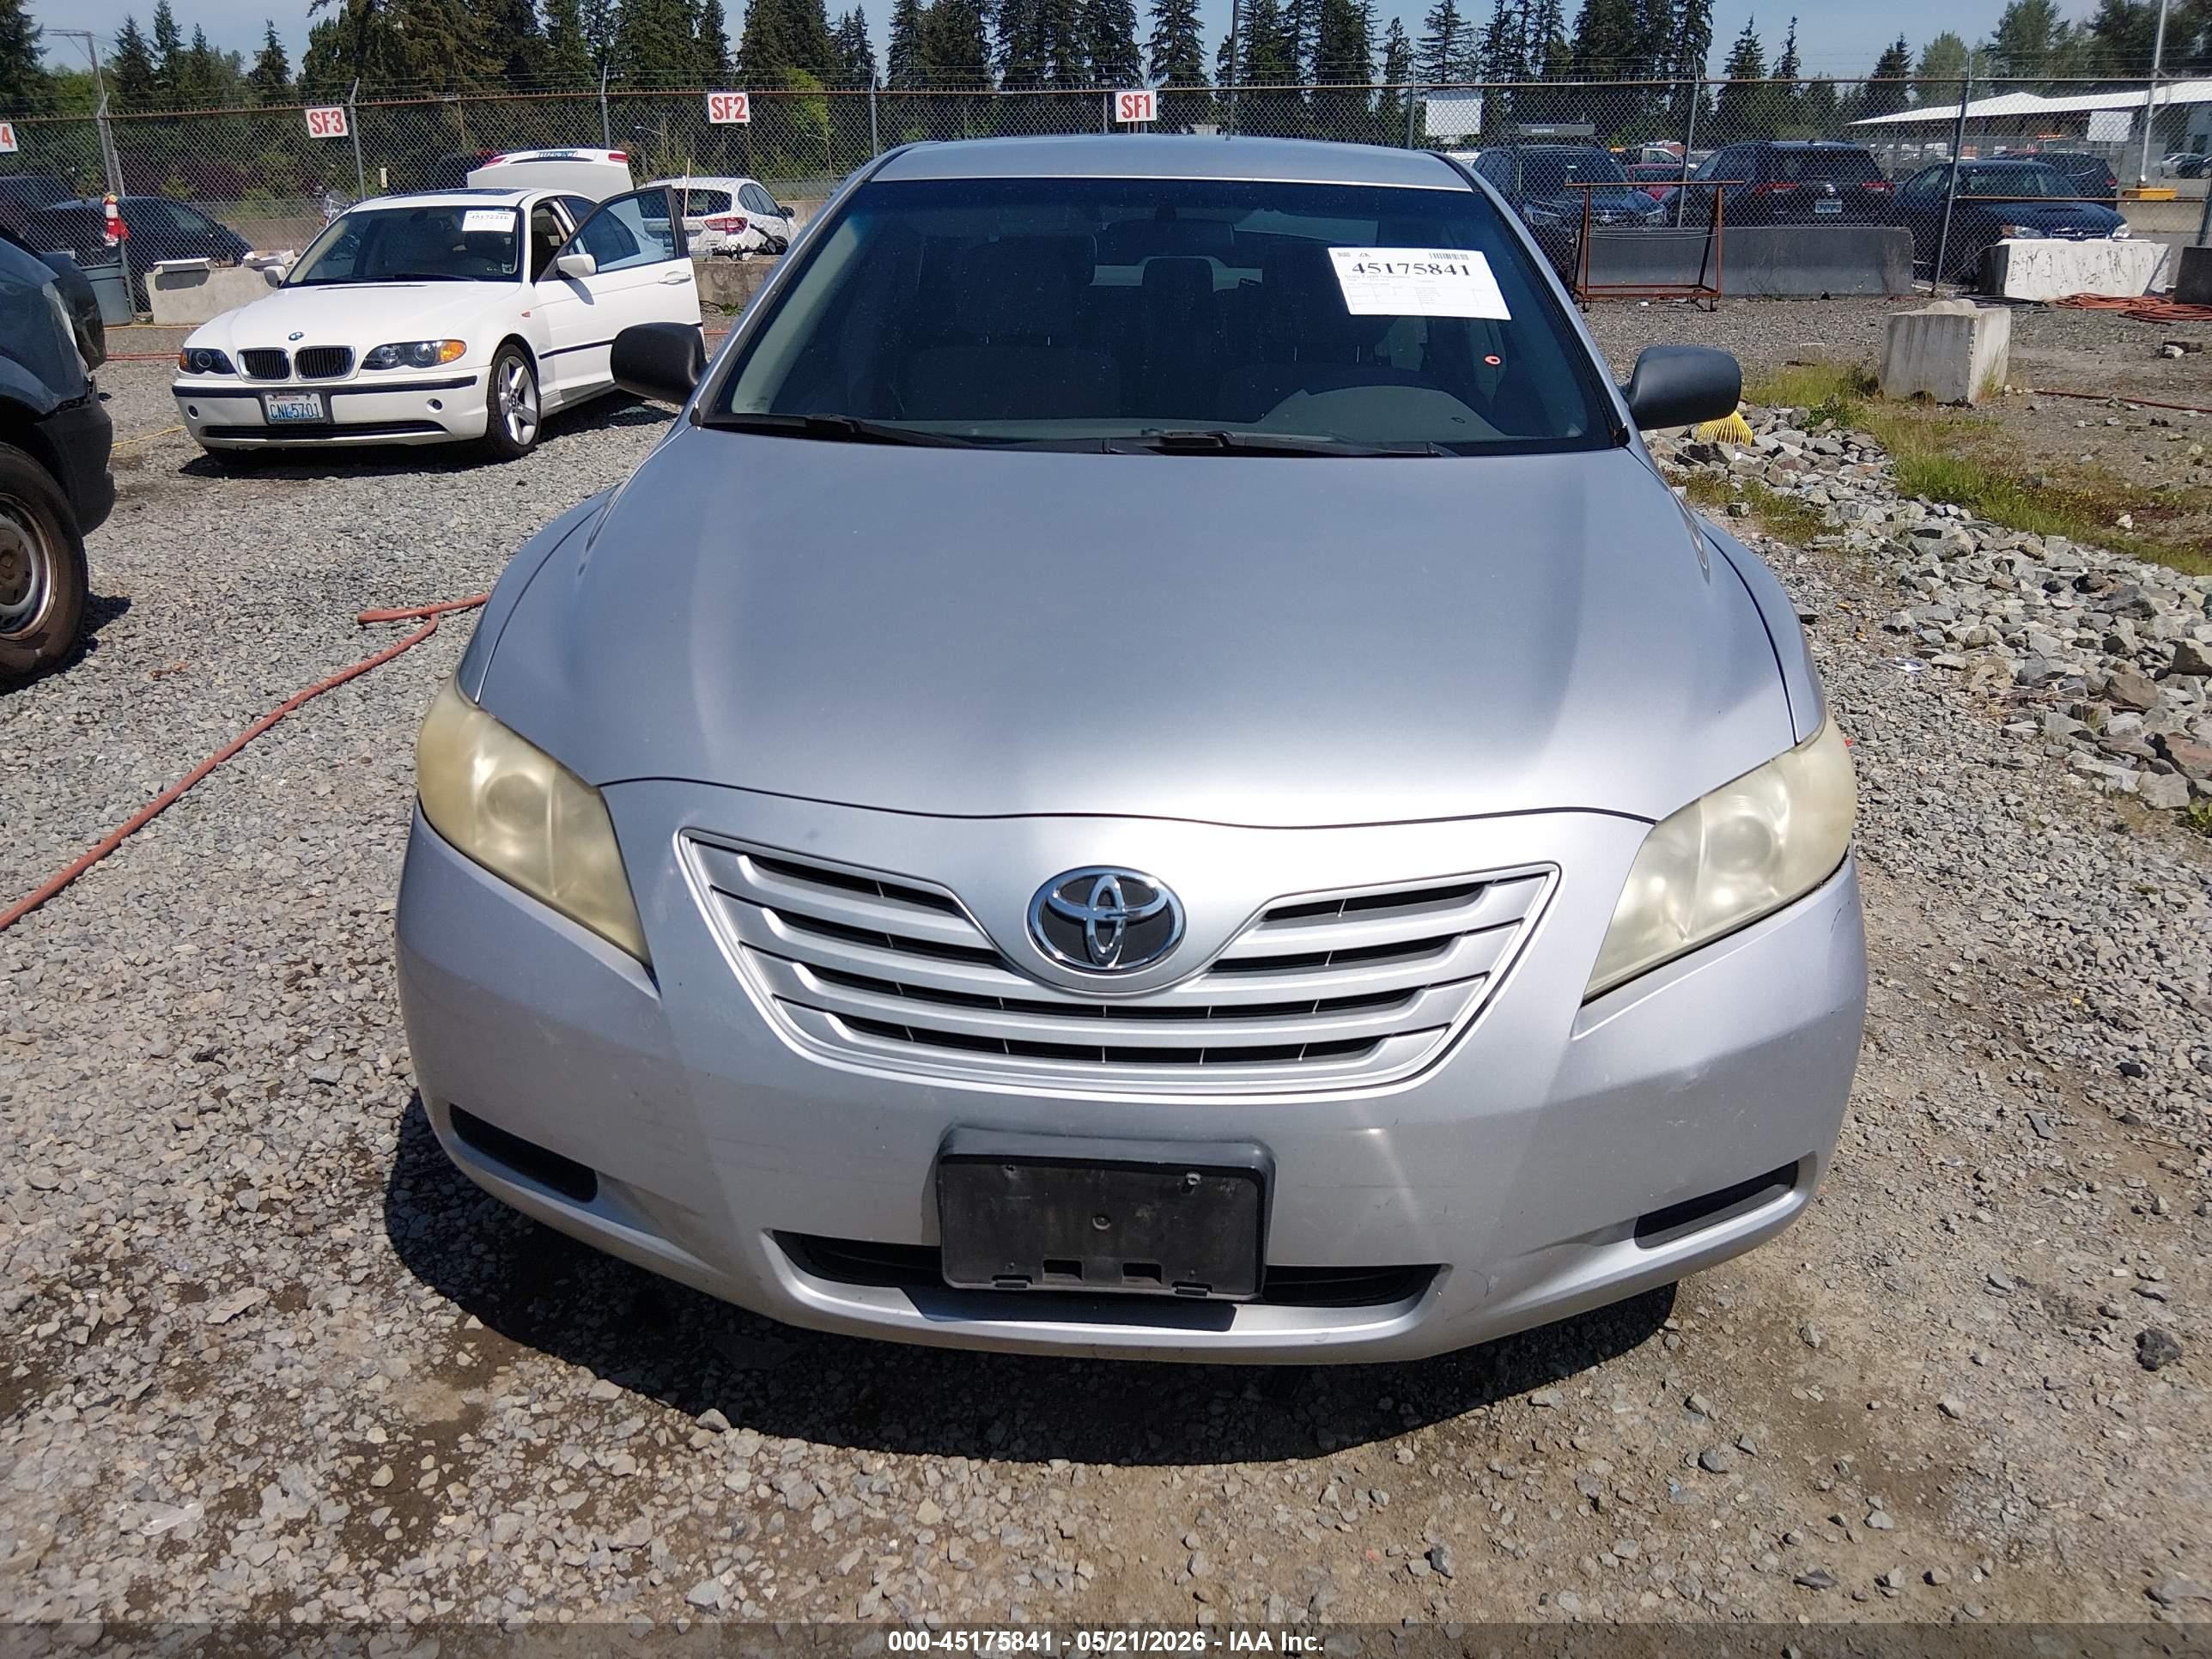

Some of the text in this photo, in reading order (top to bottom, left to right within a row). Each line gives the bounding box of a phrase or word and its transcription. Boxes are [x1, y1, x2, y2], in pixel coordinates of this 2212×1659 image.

[711, 96, 746, 119] SF2
[1121, 94, 1151, 118] SF1
[309, 111, 343, 134] SF3
[2, 126, 14, 149] 4
[1352, 262, 1470, 276] 45175841
[270, 403, 319, 419] CNL5701
